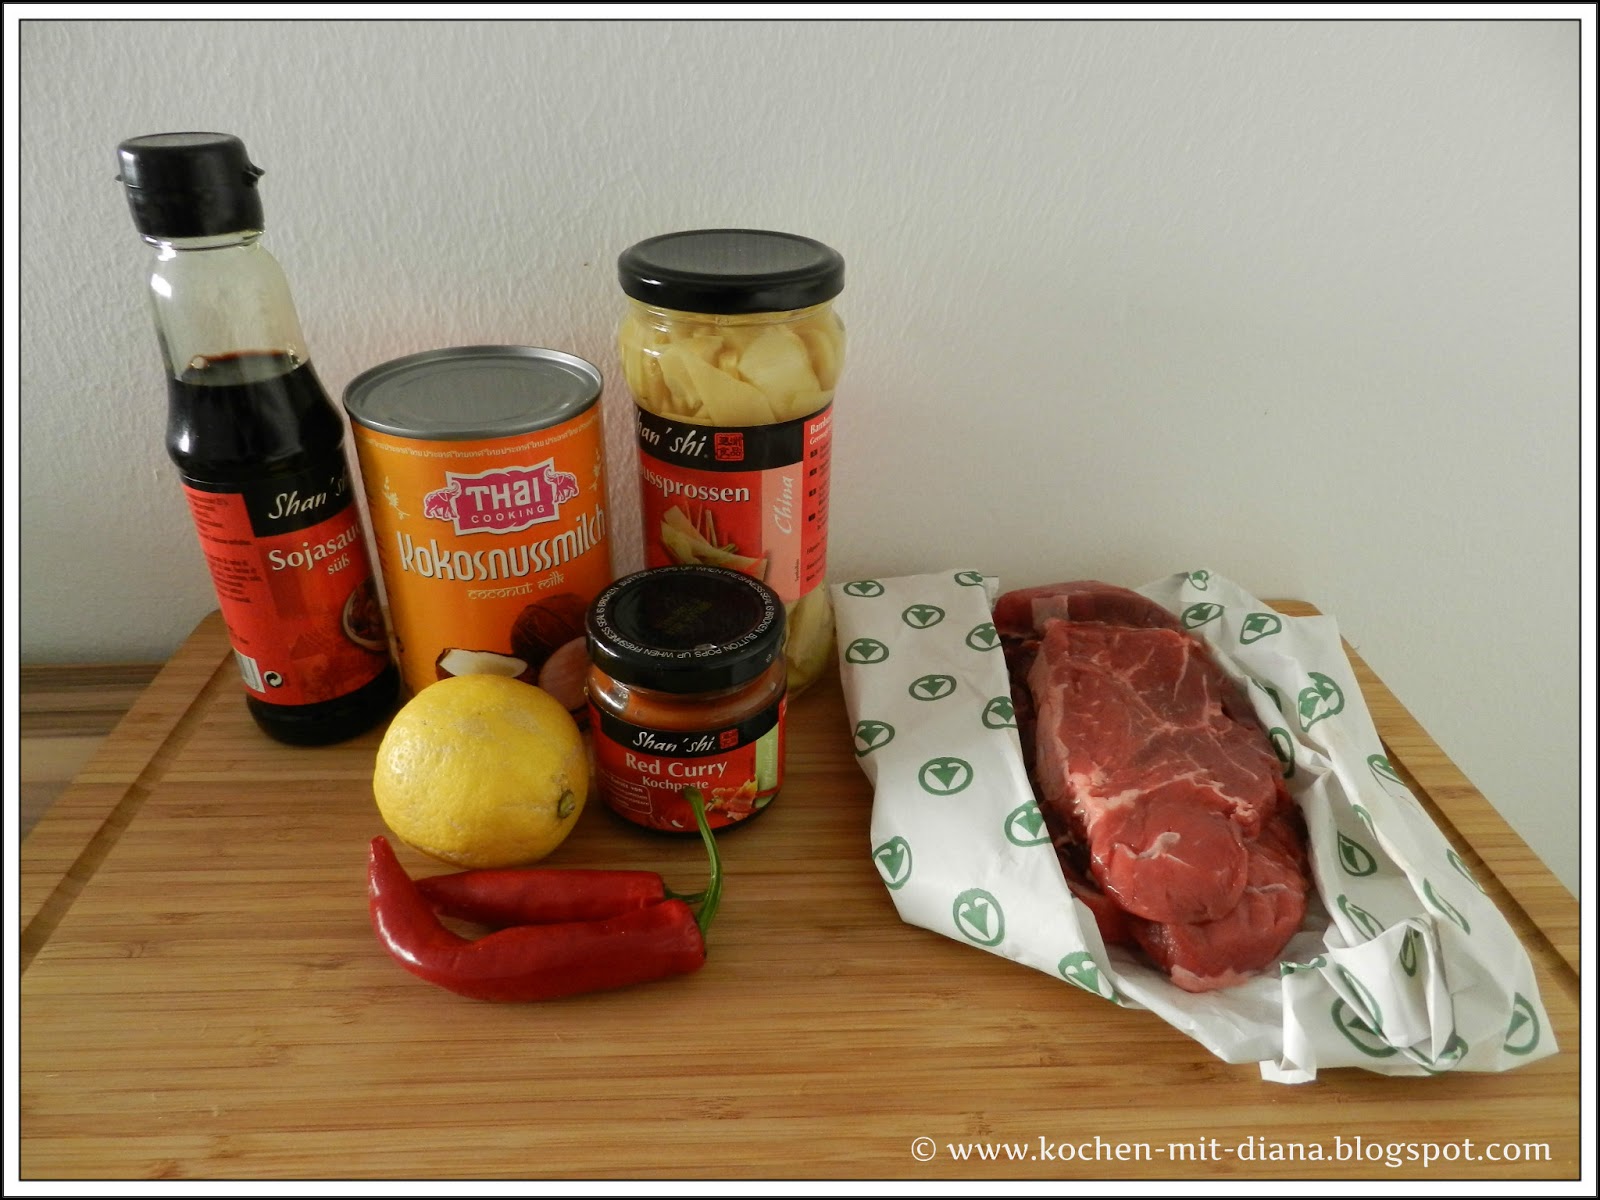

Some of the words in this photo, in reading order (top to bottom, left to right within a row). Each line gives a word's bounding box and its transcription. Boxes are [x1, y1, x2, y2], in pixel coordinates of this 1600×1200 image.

[640, 465, 750, 502] ussprossen
[471, 504, 546, 524] COOKING
[773, 475, 794, 535] China
[396, 503, 606, 582] Kokosnussmilch
[327, 552, 350, 575] süß
[467, 582, 533, 601] coconut
[537, 571, 565, 591] milk
[643, 648, 674, 658] WHEN
[694, 648, 723, 658] POPS
[722, 632, 758, 652] BUTTON
[677, 651, 692, 659] UP
[625, 751, 661, 775] Red
[667, 761, 728, 779] Curry
